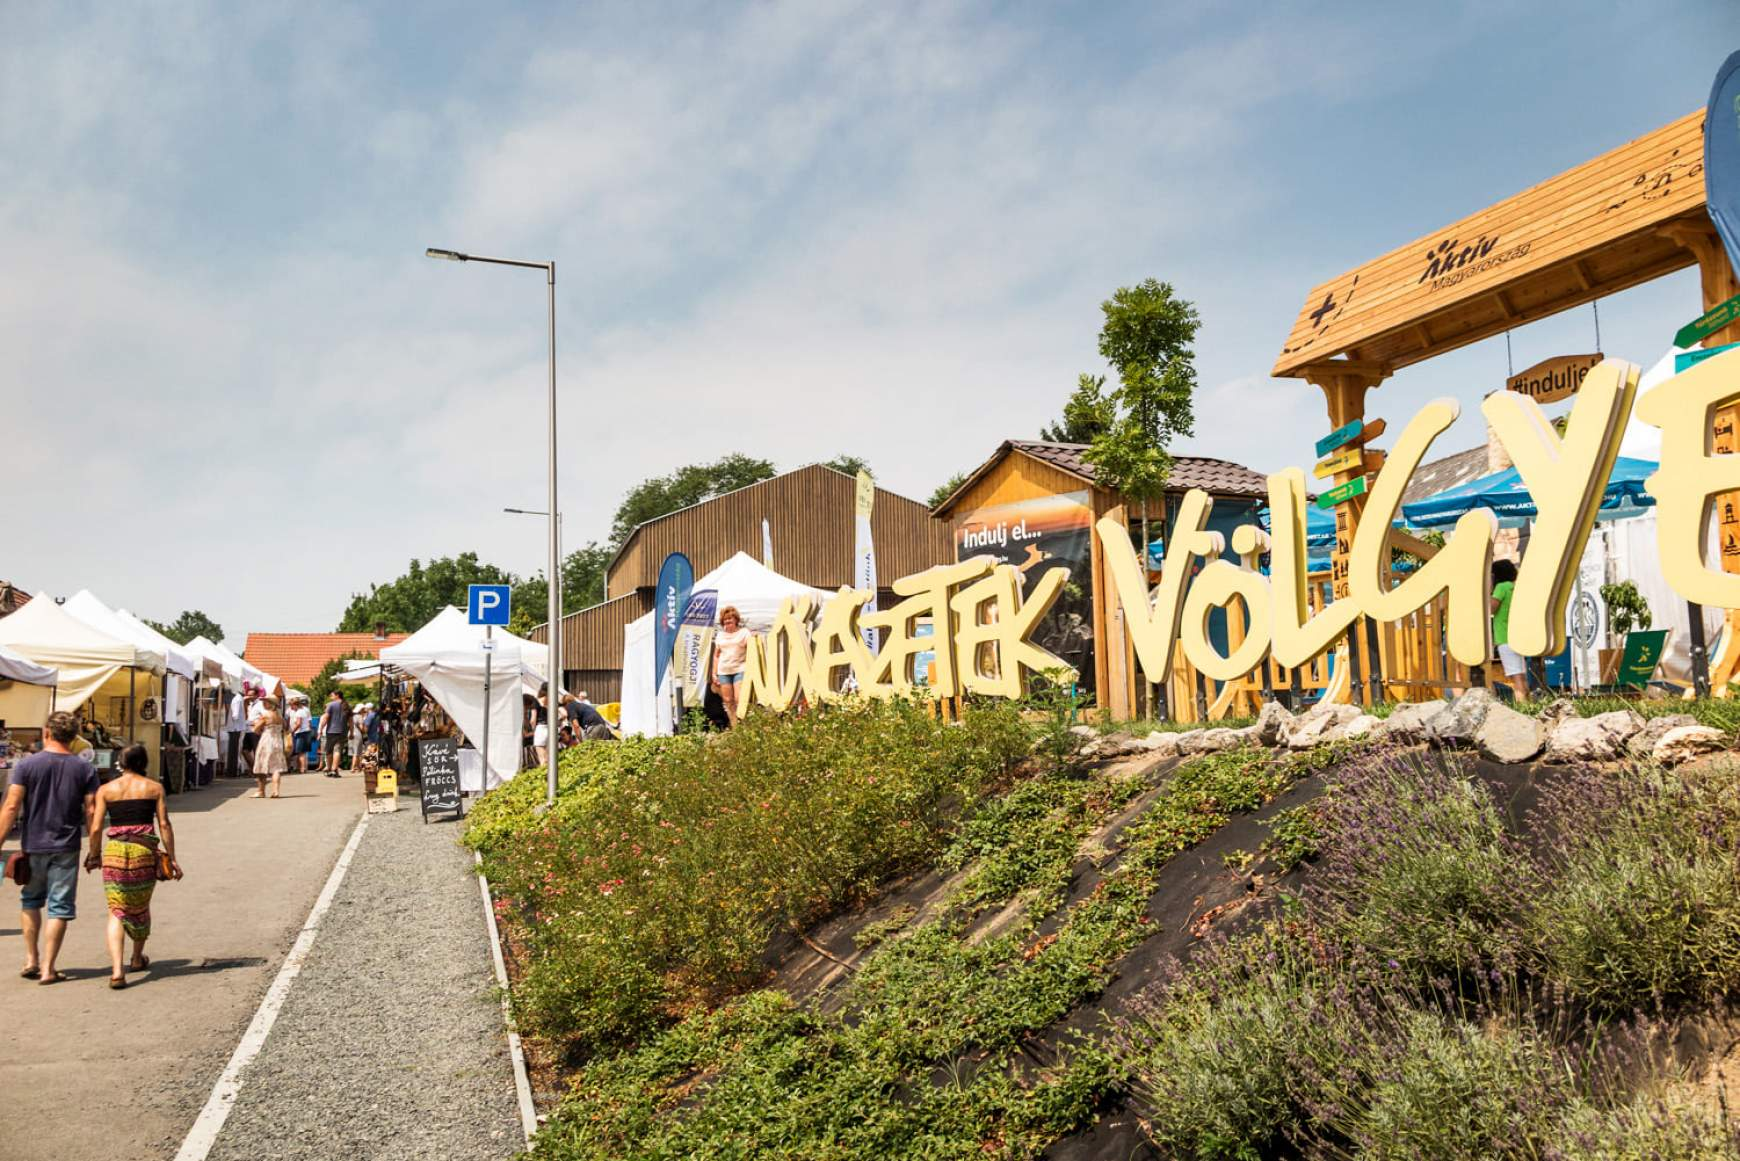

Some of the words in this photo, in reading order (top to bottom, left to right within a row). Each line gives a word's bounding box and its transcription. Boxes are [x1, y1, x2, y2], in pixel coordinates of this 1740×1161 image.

[1513, 358, 1596, 396] #indulje
[963, 521, 1008, 548] Indulj
[478, 591, 501, 620] P
